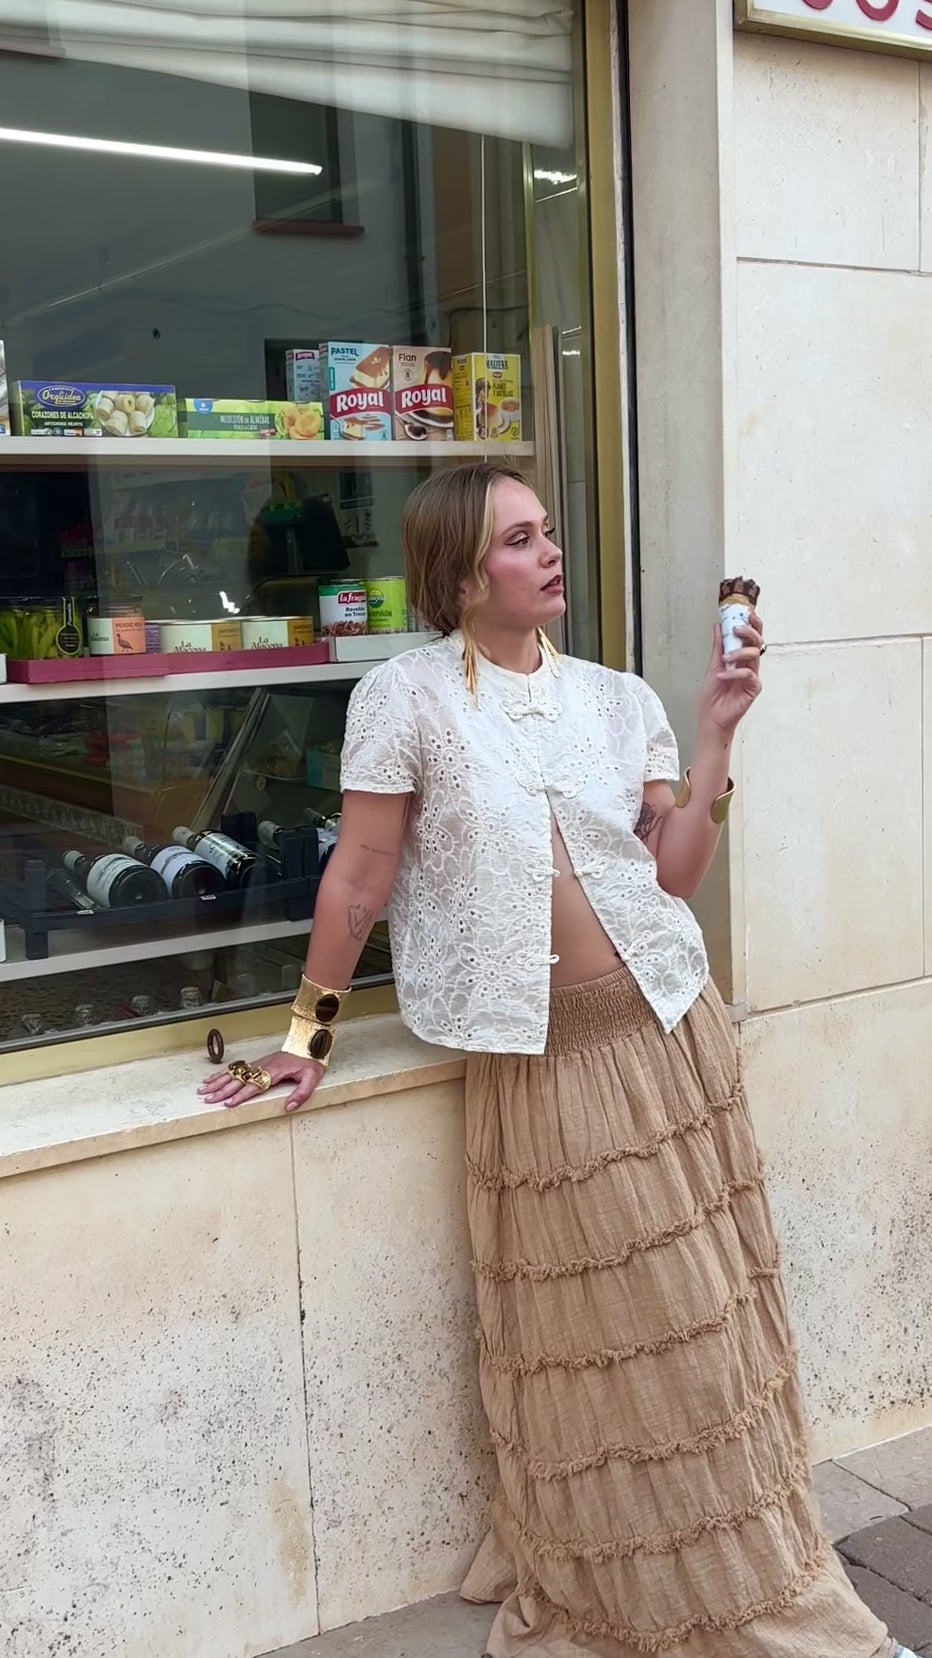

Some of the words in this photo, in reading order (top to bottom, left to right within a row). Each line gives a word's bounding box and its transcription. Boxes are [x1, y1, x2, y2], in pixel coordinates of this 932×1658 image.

[331, 346, 359, 356] PASTEL
[398, 353, 417, 362] Flan
[336, 391, 384, 413] Royal
[401, 387, 447, 408] Royal
[32, 411, 59, 419] CORAZONES
